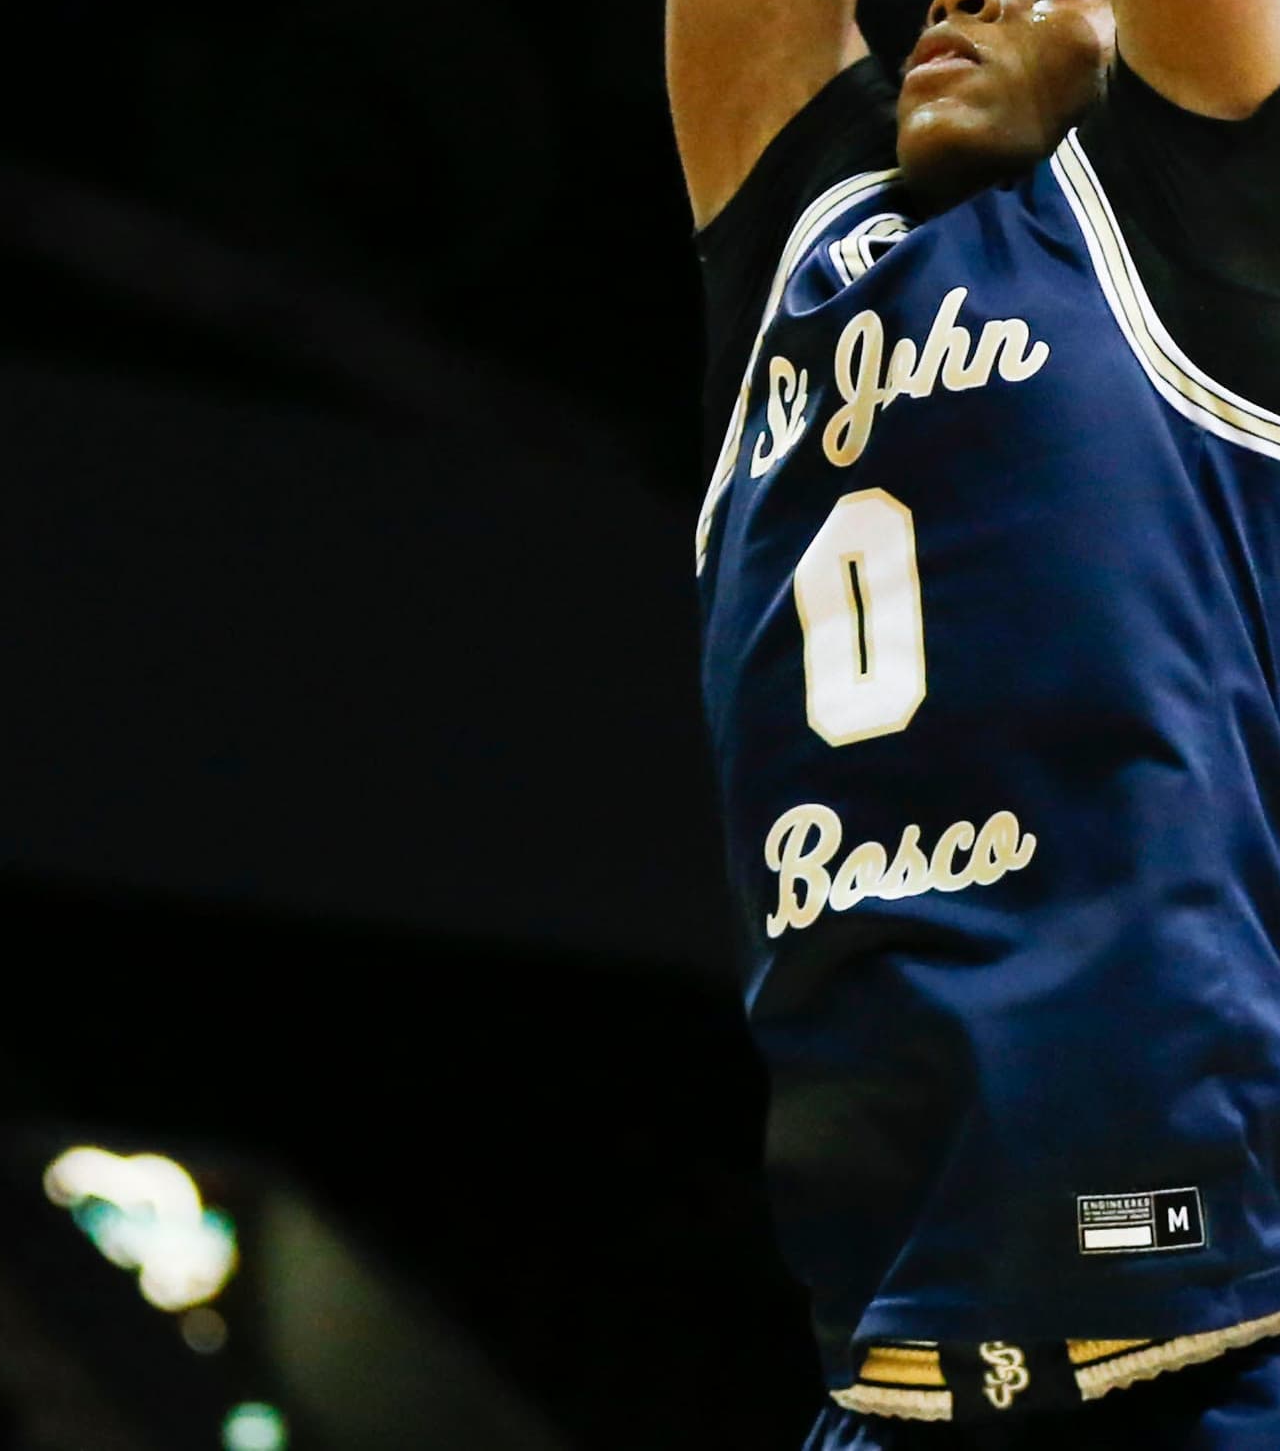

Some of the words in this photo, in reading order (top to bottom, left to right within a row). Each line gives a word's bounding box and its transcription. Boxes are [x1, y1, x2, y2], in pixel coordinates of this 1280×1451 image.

[822, 286, 1049, 468] John
[794, 486, 926, 748] 0
[764, 803, 1037, 939] Bosco
[1167, 1205, 1190, 1233] M
